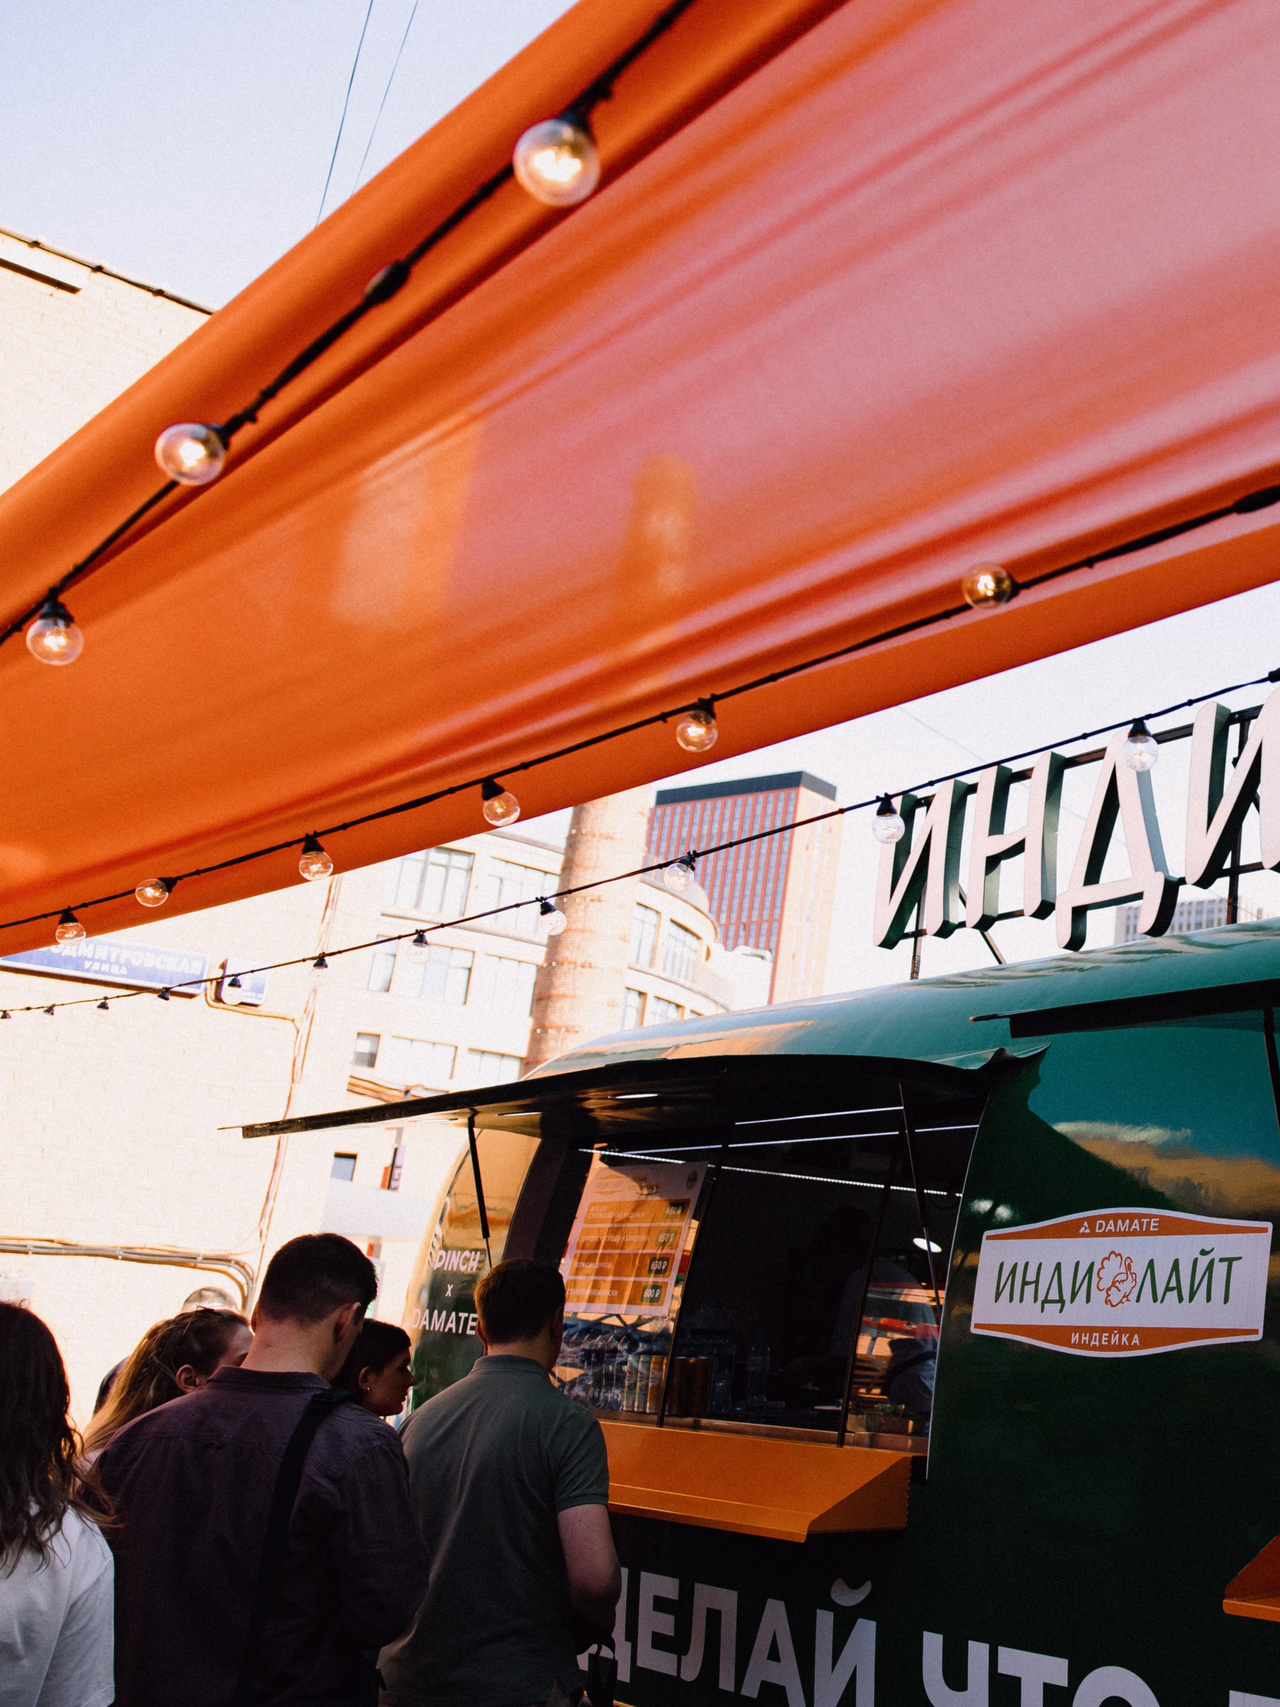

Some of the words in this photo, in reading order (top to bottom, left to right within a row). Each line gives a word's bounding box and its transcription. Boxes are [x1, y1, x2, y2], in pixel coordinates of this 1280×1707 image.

[39, 942, 203, 975] ОДМИТРОВСКАЯ
[1095, 1218, 1160, 1233] DAMATE
[433, 1250, 481, 1272] PINCH
[994, 1259, 1095, 1314] ИНДИ
[1135, 1246, 1243, 1305] ЛАЙТ
[410, 1308, 479, 1336] DAMATE
[1071, 1330, 1140, 1347] ИНДЕЙКА
